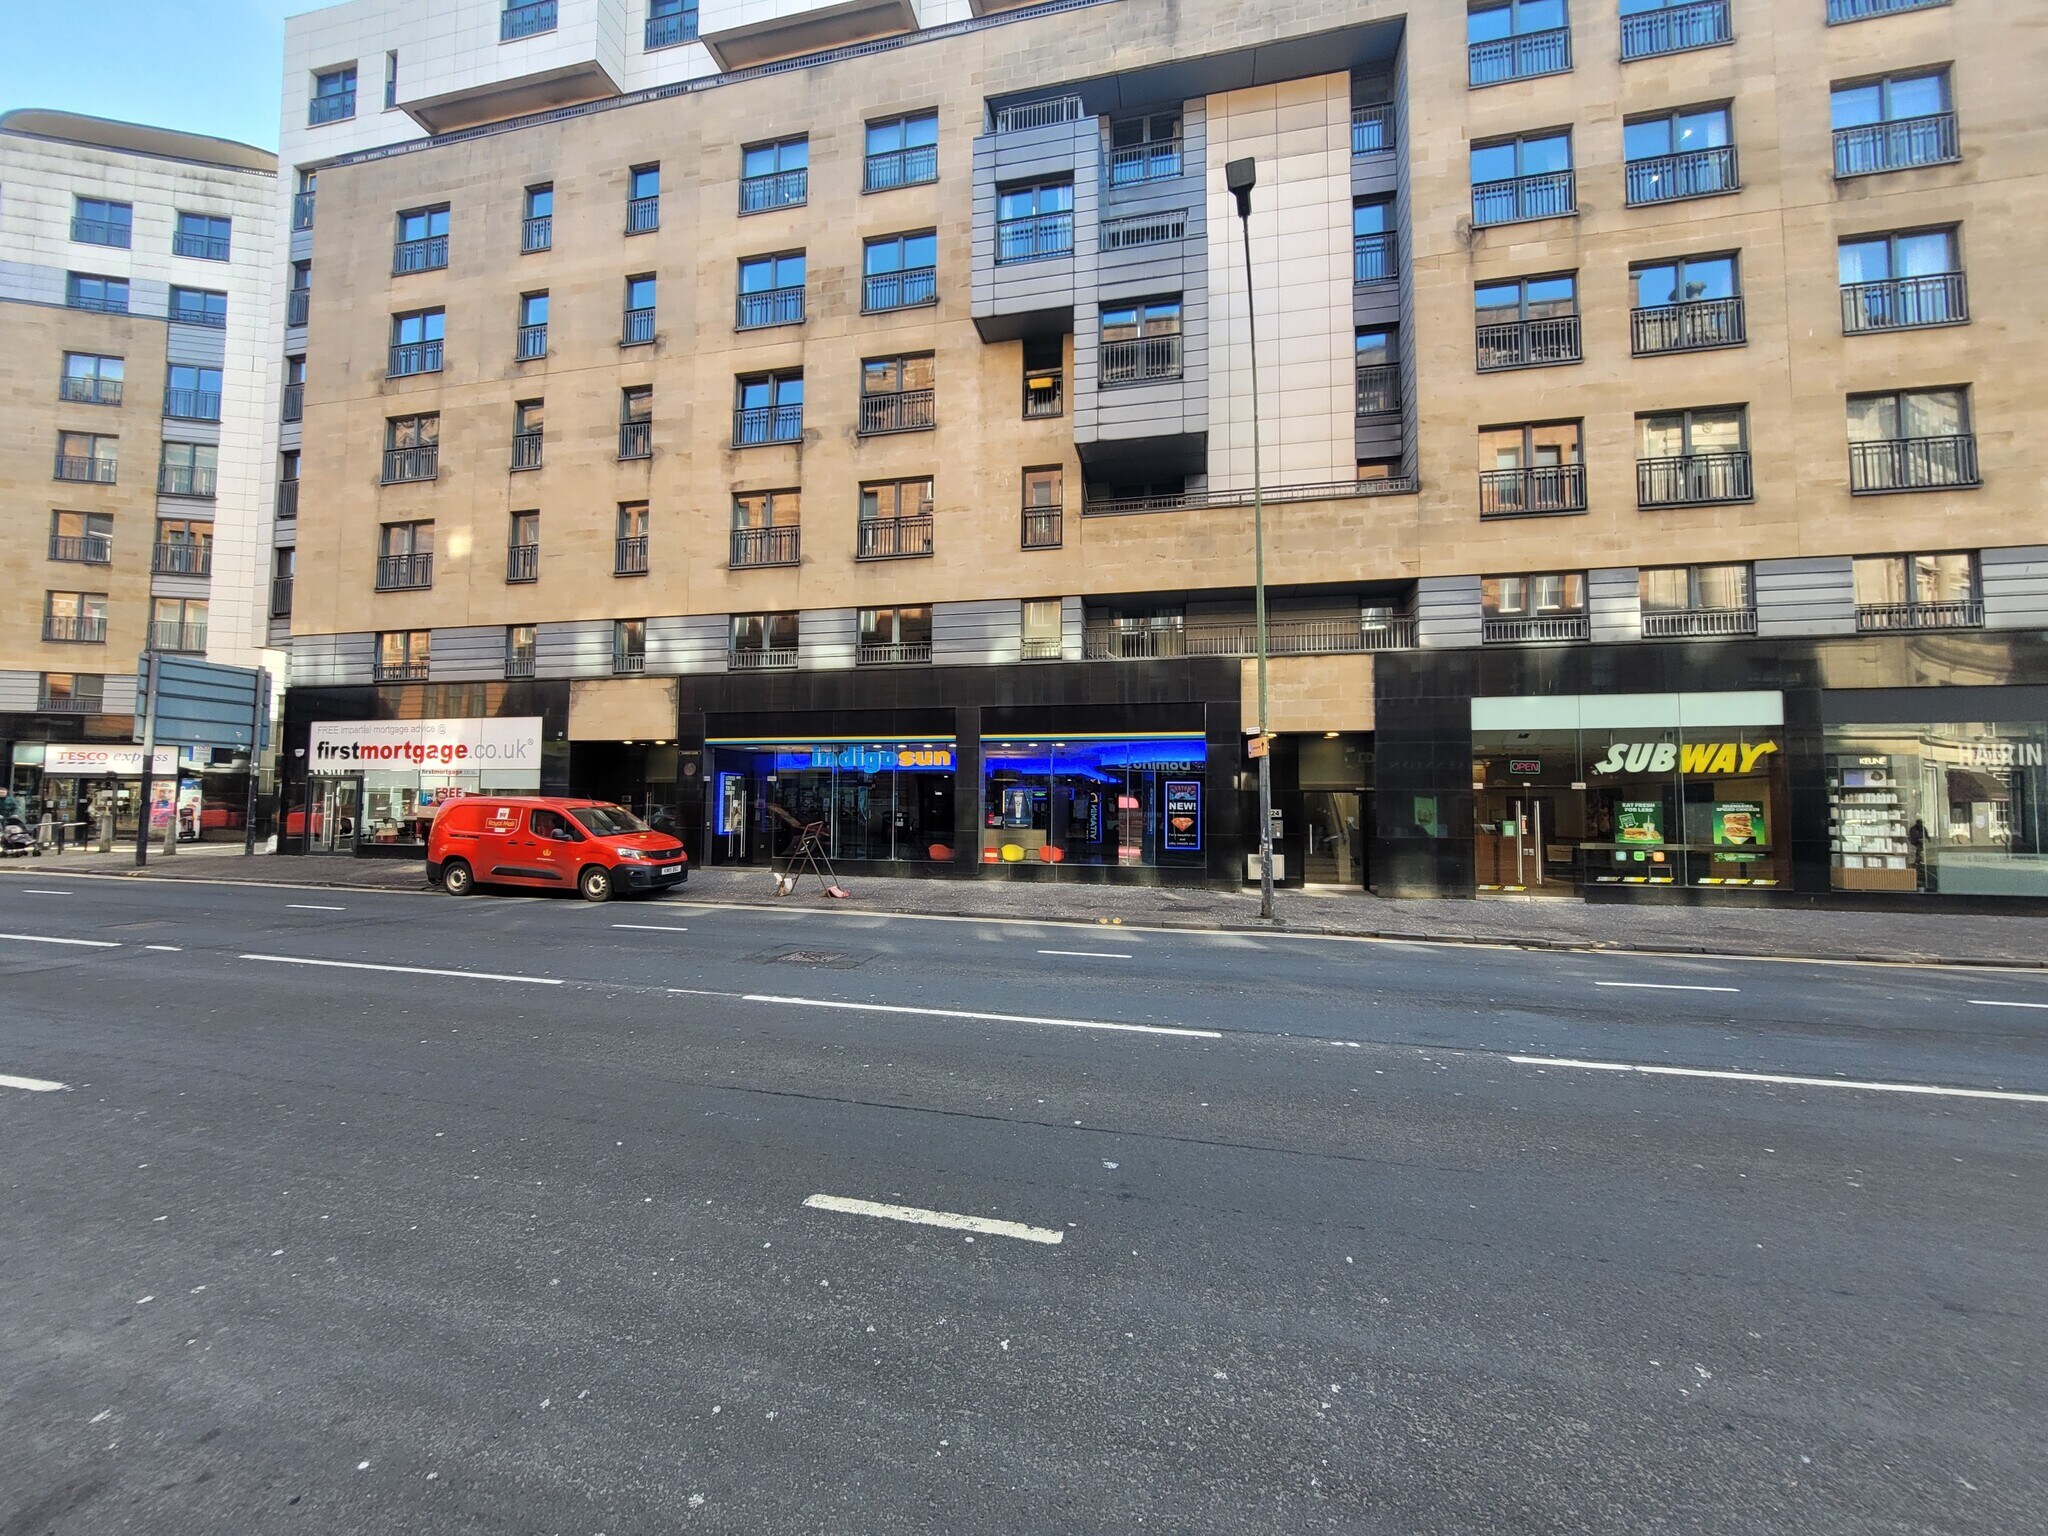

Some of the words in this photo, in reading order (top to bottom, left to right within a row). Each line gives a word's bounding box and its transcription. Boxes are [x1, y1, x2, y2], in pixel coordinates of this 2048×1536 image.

[317, 725, 339, 735] FREE
[341, 724, 371, 736] impartial
[373, 724, 408, 736] mortgage
[410, 723, 436, 734] advice
[57, 751, 109, 761] TESCO
[113, 752, 169, 764] expss
[317, 738, 527, 764] firstmortgage.co.uk
[1594, 739, 1778, 775] SUBWAY
[1959, 743, 2016, 766] HAIR
[2018, 743, 2043, 766] IN
[1511, 762, 1539, 771] OPEN
[435, 787, 463, 798] FREE
[1168, 802, 1197, 811] NEW!
